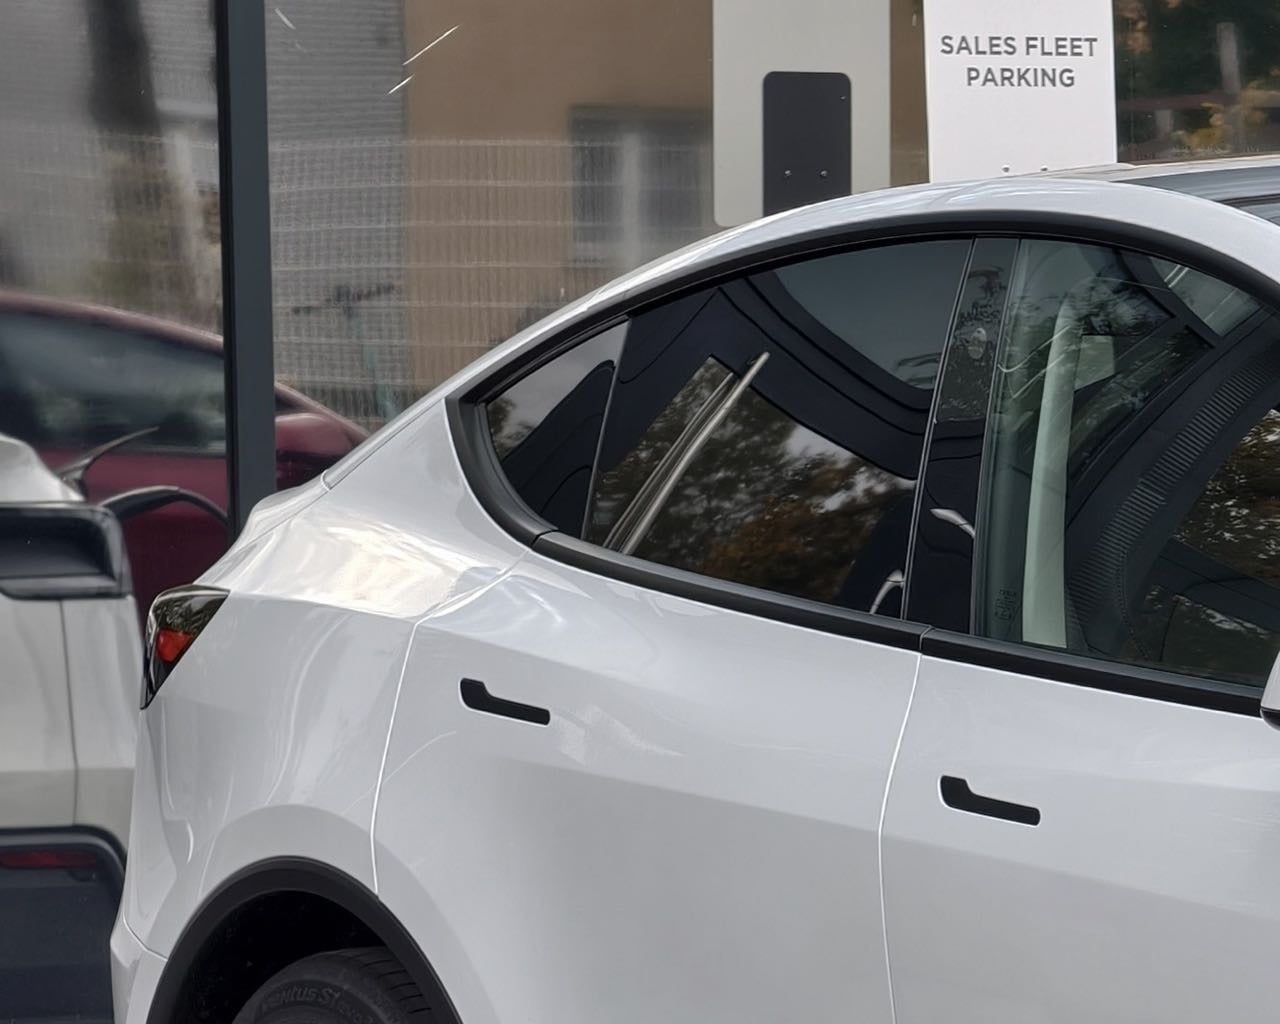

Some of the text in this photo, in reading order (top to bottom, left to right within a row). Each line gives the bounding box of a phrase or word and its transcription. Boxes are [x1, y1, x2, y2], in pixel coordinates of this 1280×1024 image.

[940, 35, 1098, 57] SALES FLEET
[966, 66, 1075, 87] PARKING
